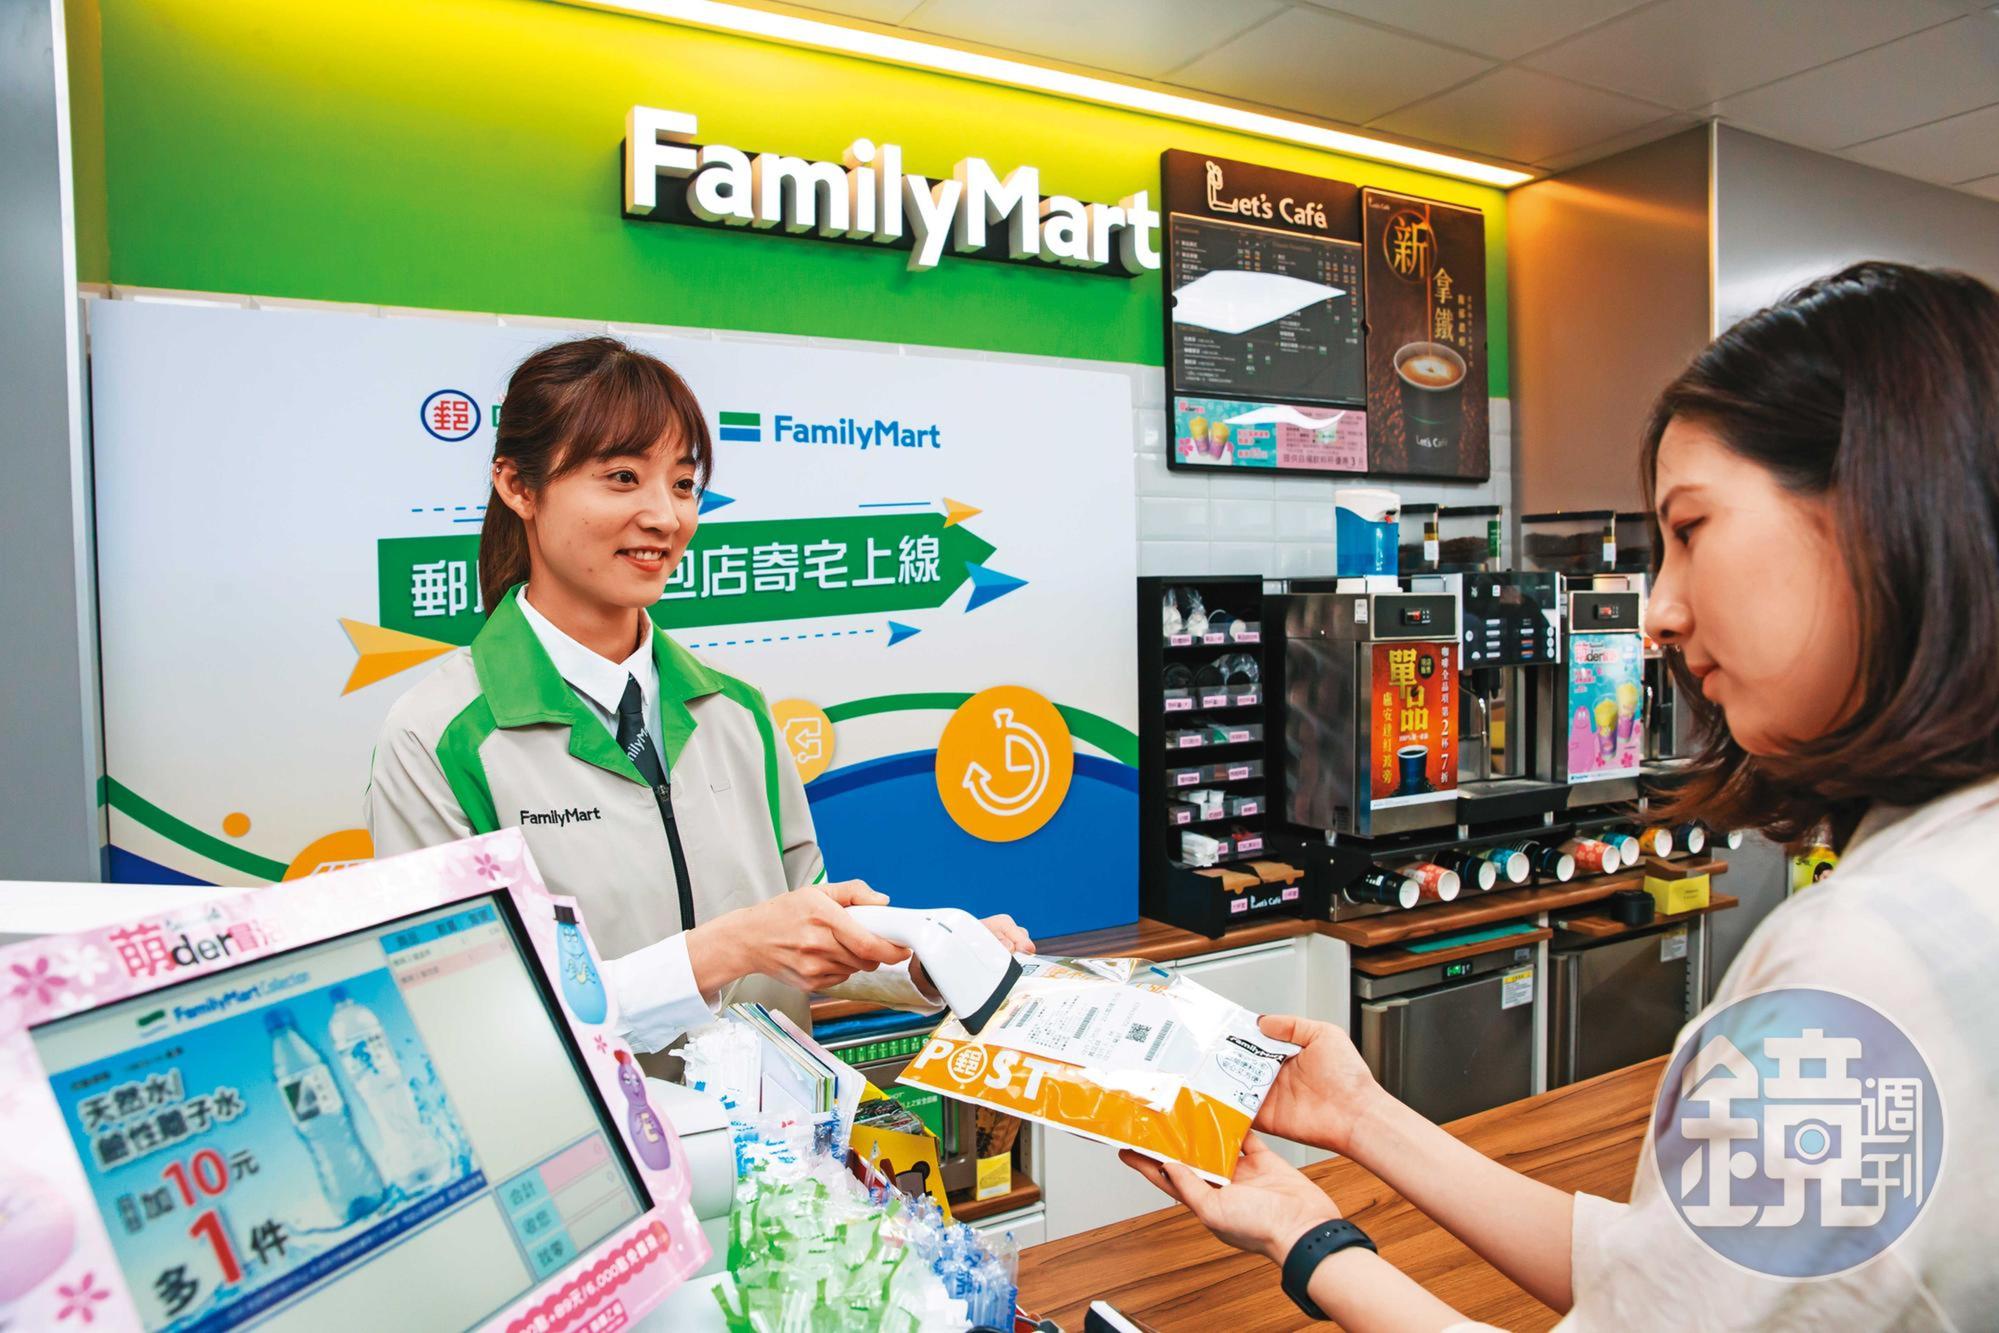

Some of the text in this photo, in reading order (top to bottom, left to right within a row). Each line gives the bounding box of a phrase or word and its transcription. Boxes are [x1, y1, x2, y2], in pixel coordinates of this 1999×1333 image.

[626, 104, 1161, 271] FamilyMart
[1205, 160, 1328, 229] Let's Café
[1392, 215, 1429, 279] 新
[774, 414, 941, 450] FamilyMart
[520, 807, 601, 827] FamilyMart
